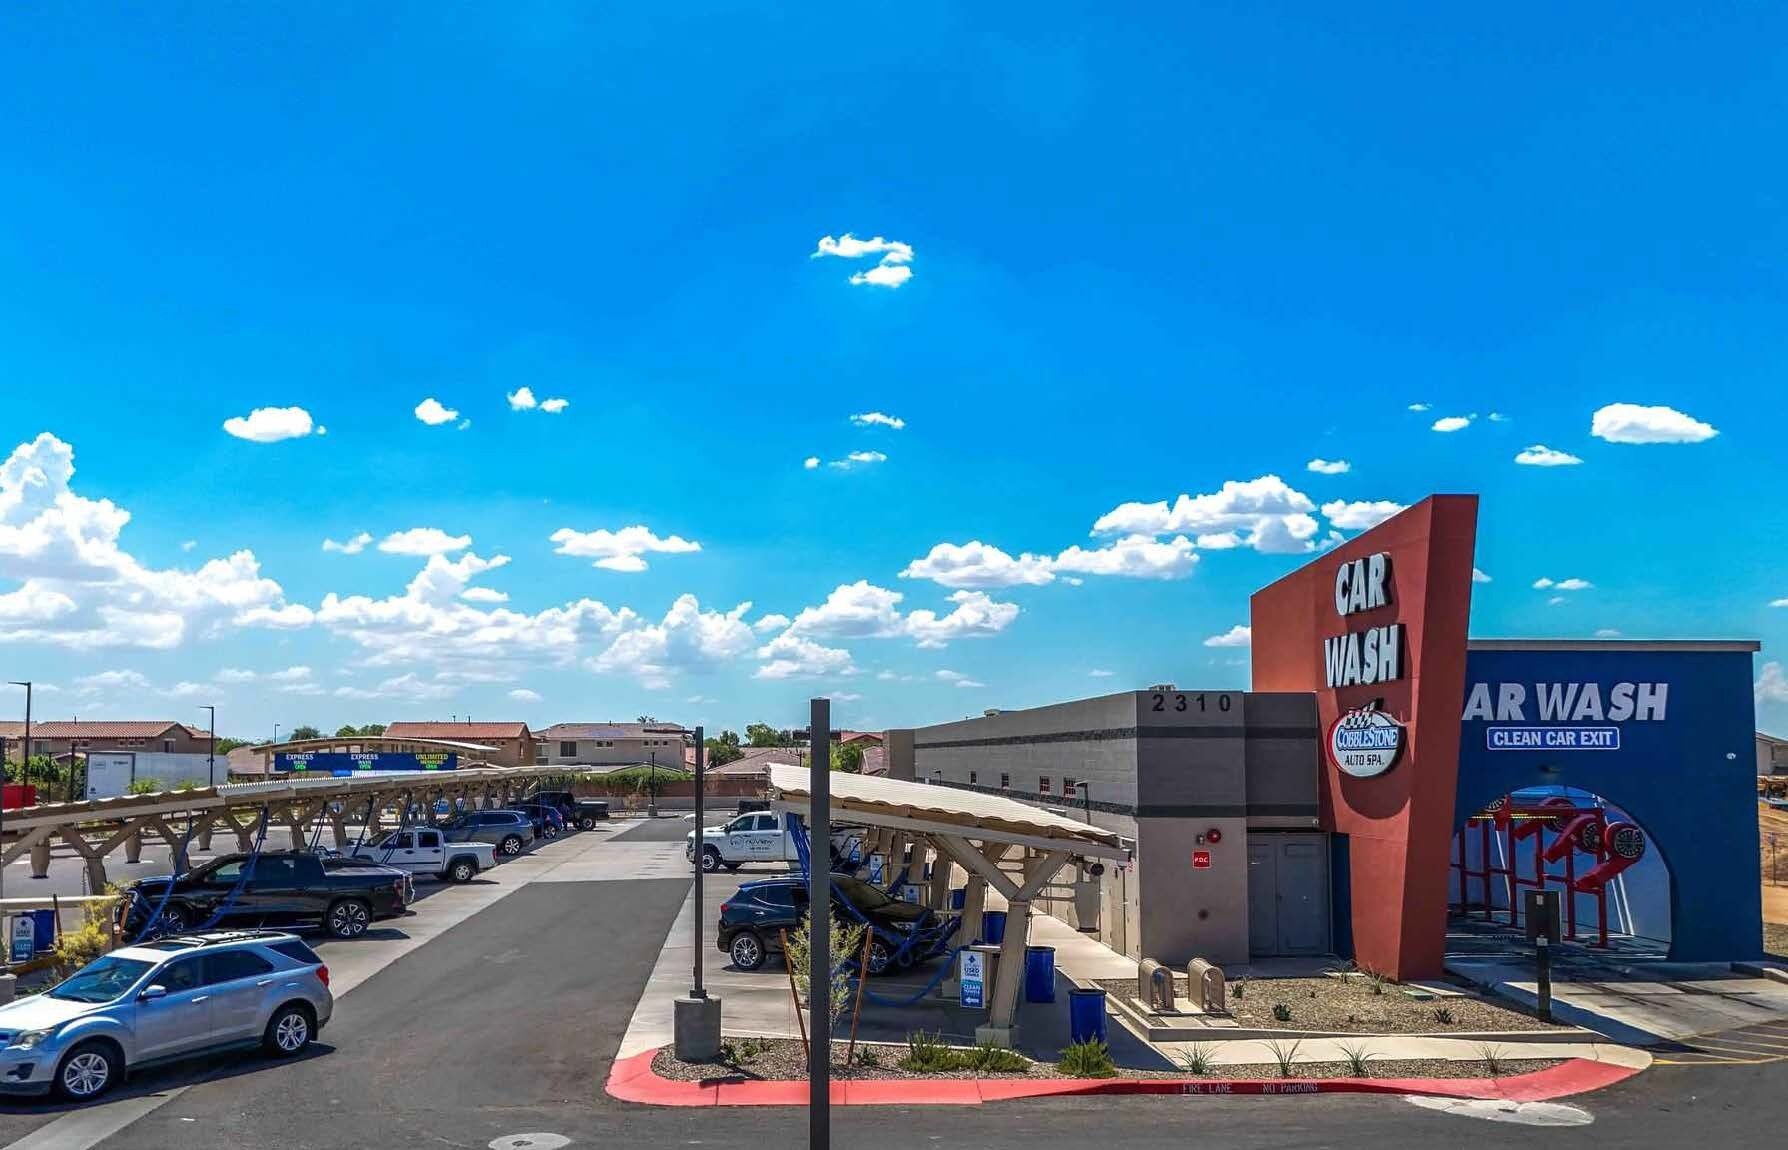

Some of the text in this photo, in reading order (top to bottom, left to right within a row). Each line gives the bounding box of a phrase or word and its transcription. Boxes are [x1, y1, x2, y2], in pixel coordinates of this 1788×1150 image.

[1335, 552, 1390, 617] CAR
[1324, 624, 1402, 688] WASH
[1152, 693, 1231, 712] 2310
[1461, 682, 1669, 722] AR WASH
[1493, 731, 1613, 746] CLEAN CAR EXIT
[1345, 754, 1364, 766] AUTO
[1182, 1082, 1318, 1094] FIRE LANE NO PARKING
